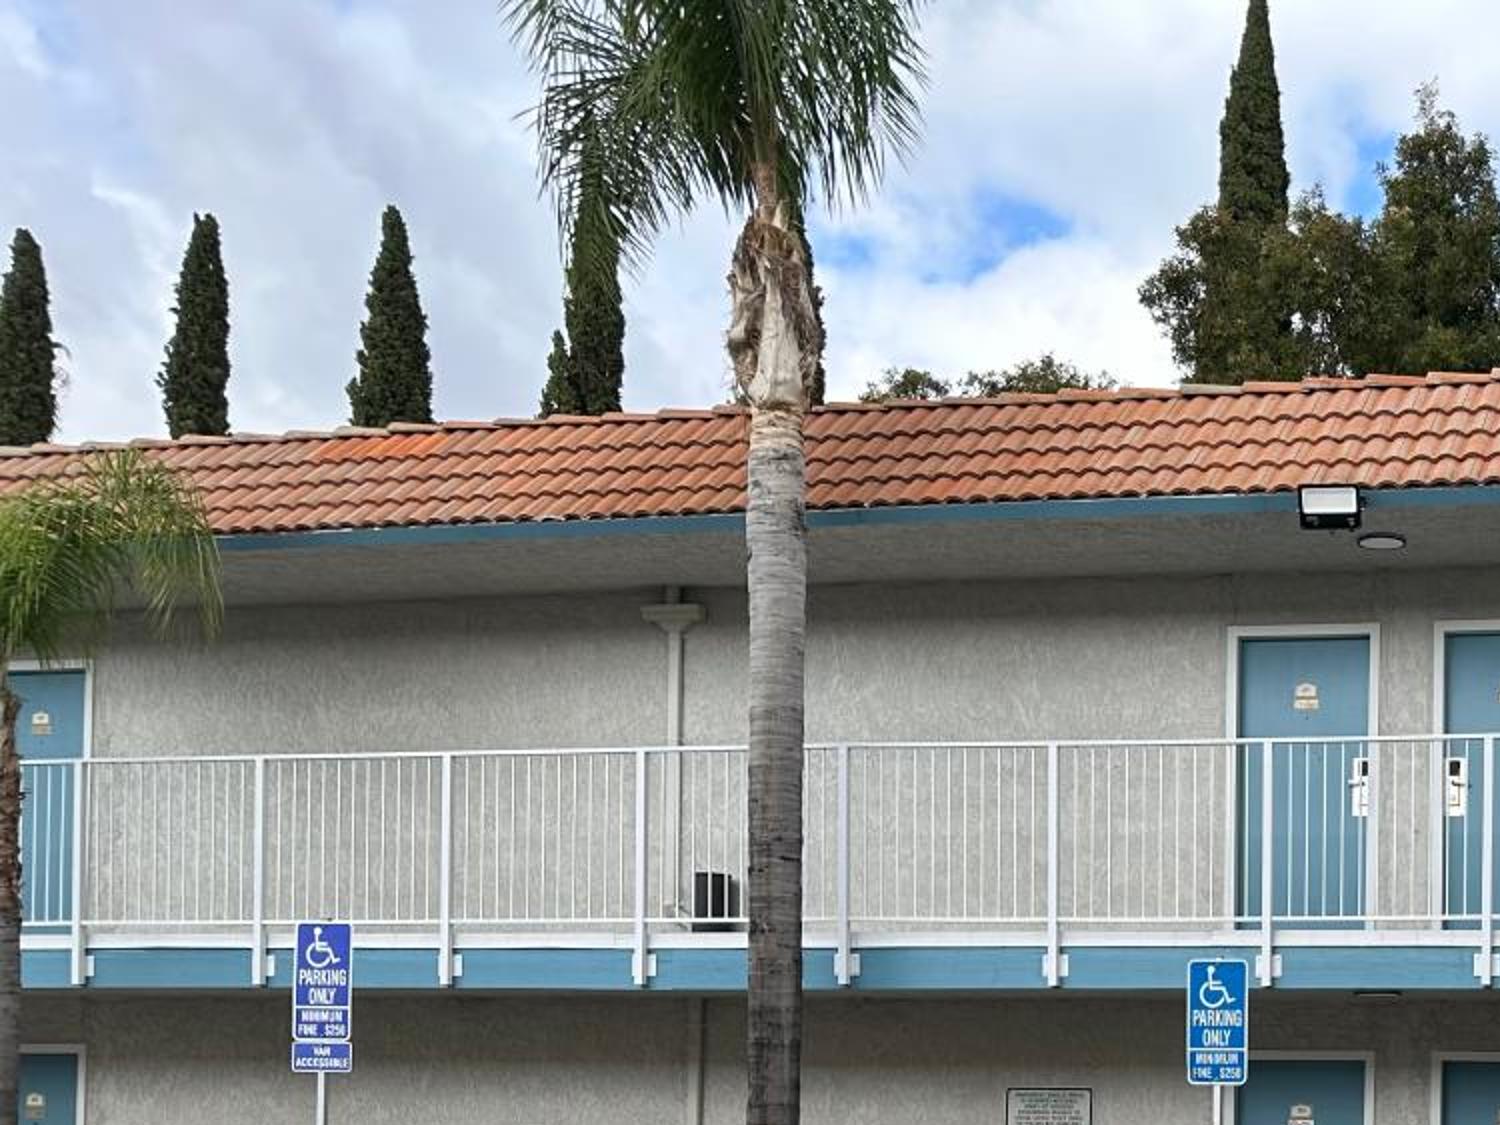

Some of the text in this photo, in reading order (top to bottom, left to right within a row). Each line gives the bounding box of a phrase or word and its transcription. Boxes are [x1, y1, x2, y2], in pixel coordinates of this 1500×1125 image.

[299, 969, 346, 986] PARKING
[308, 987, 337, 1004] ONLY
[1193, 1009, 1242, 1026] PARKING
[1202, 1029, 1231, 1046] ONLY
